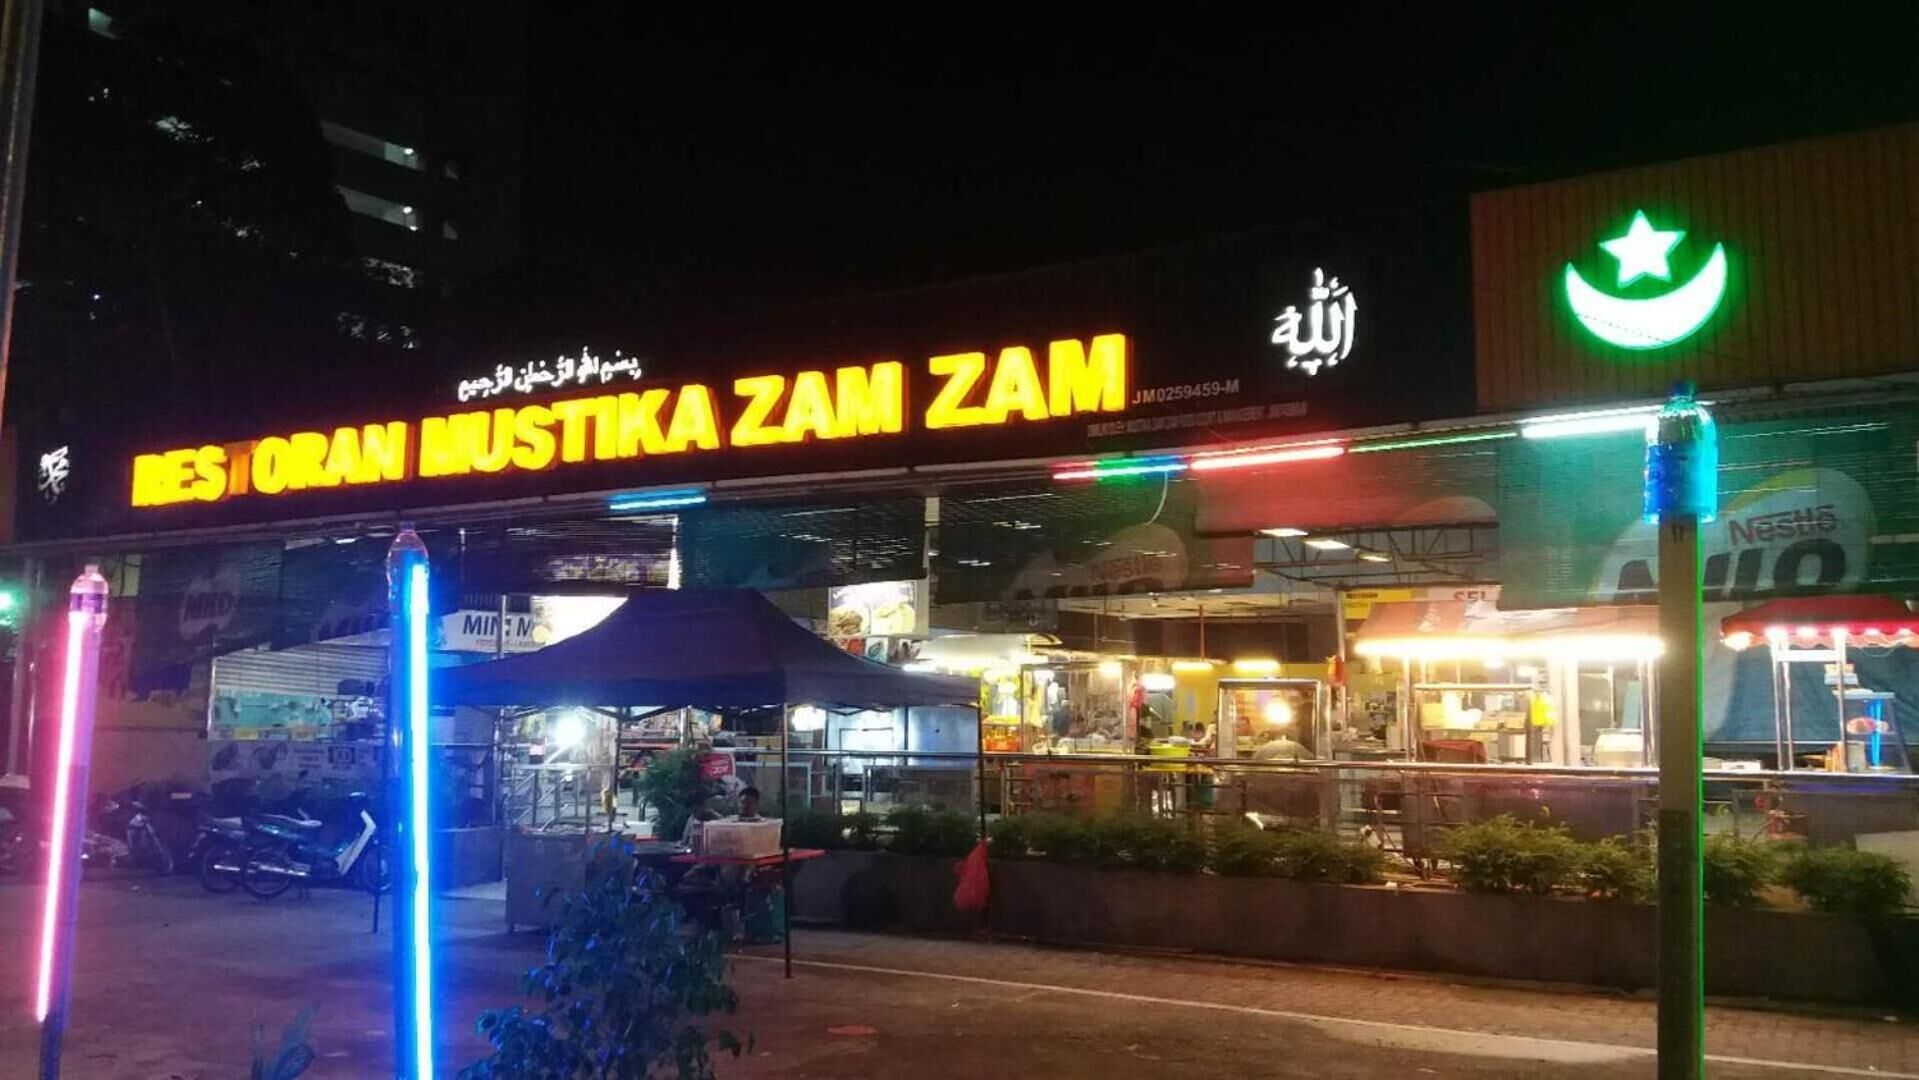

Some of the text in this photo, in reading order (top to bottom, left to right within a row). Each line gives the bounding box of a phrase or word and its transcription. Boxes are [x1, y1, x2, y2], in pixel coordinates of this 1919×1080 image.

[131, 420, 408, 508] RESTORAN
[418, 384, 720, 478] MUSTIKA
[730, 360, 904, 448] ZAM
[924, 332, 1128, 430] ZAM
[1132, 379, 1240, 404] JM0259459-M
